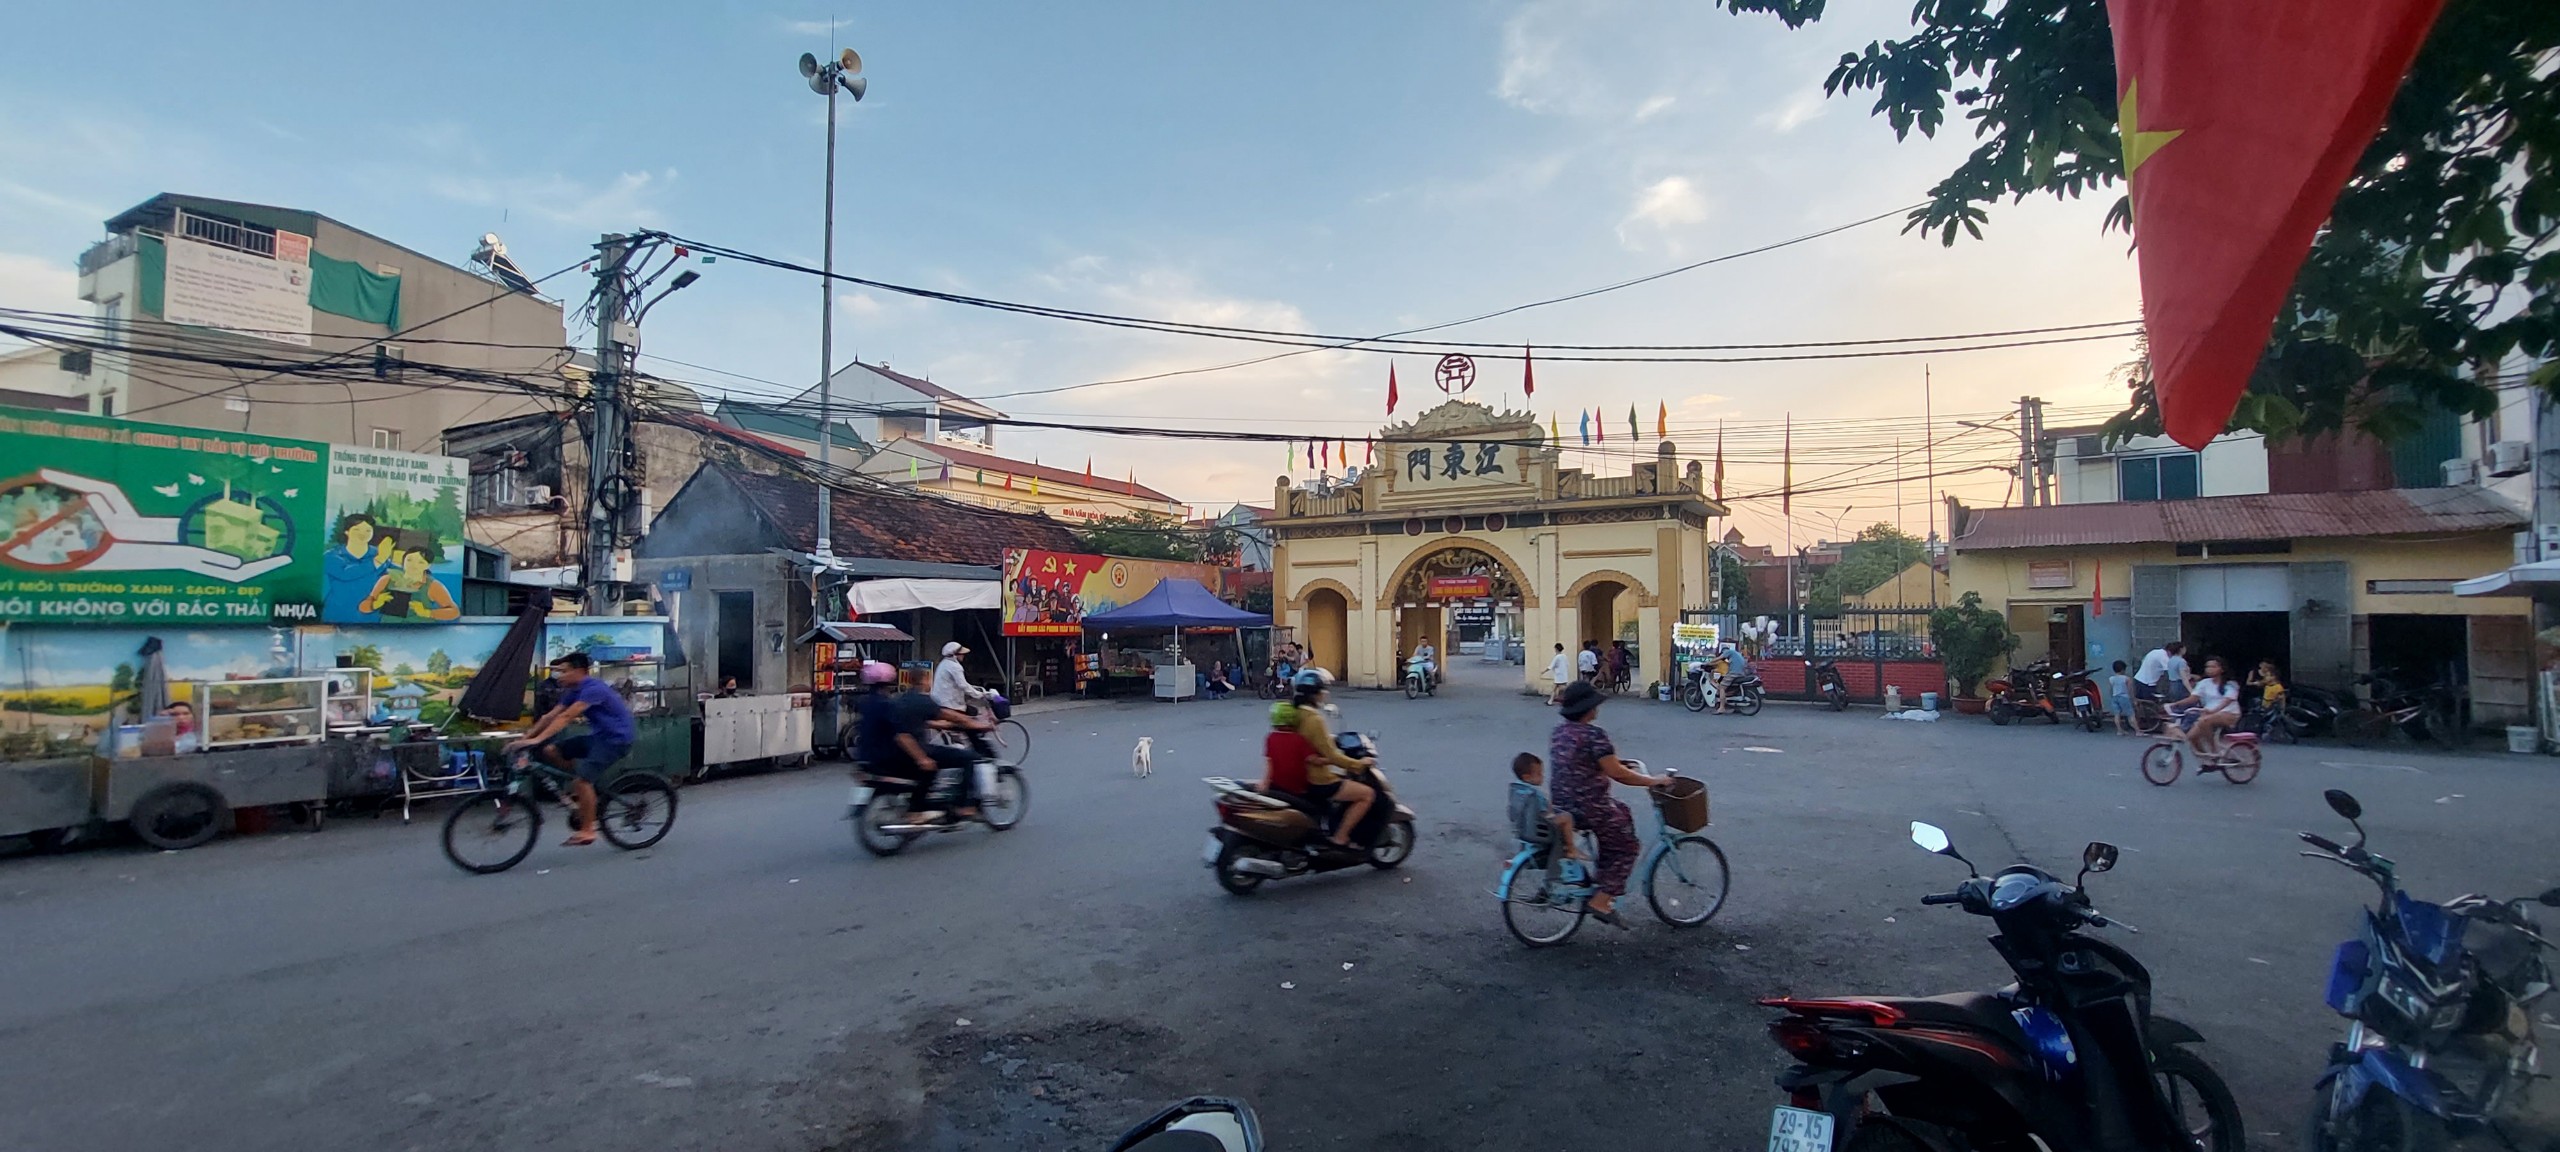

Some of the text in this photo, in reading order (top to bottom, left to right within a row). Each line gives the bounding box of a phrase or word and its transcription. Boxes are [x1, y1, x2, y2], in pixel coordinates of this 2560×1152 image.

[133, 431, 179, 449] CHUNG
[181, 436, 202, 451] TAY
[203, 437, 229, 454] BẢO
[231, 441, 247, 457] VỆ
[248, 443, 272, 457] MÔI
[273, 446, 318, 463] TRƯỜNG
[334, 450, 429, 470] TRỒNG THÊM MỘT CÂY XANH
[333, 464, 467, 487] LÀ GÓP PHẦN BẢO VỆ MÔI TRƯỜNG
[1063, 507, 1074, 516] NHÀ
[1075, 508, 1086, 518] VĂN
[1087, 511, 1098, 520] HÓA
[18, 580, 53, 592] MÔI
[58, 580, 126, 593] TRƯỜNG
[131, 584, 174, 594] XANH
[186, 585, 226, 597] SẠCH
[237, 586, 264, 598] ĐẸP
[0, 596, 317, 620] ÓI KHÔNG VỚI RÁC THẢI NHỰA
[1779, 1111, 1824, 1140] 29-X5
